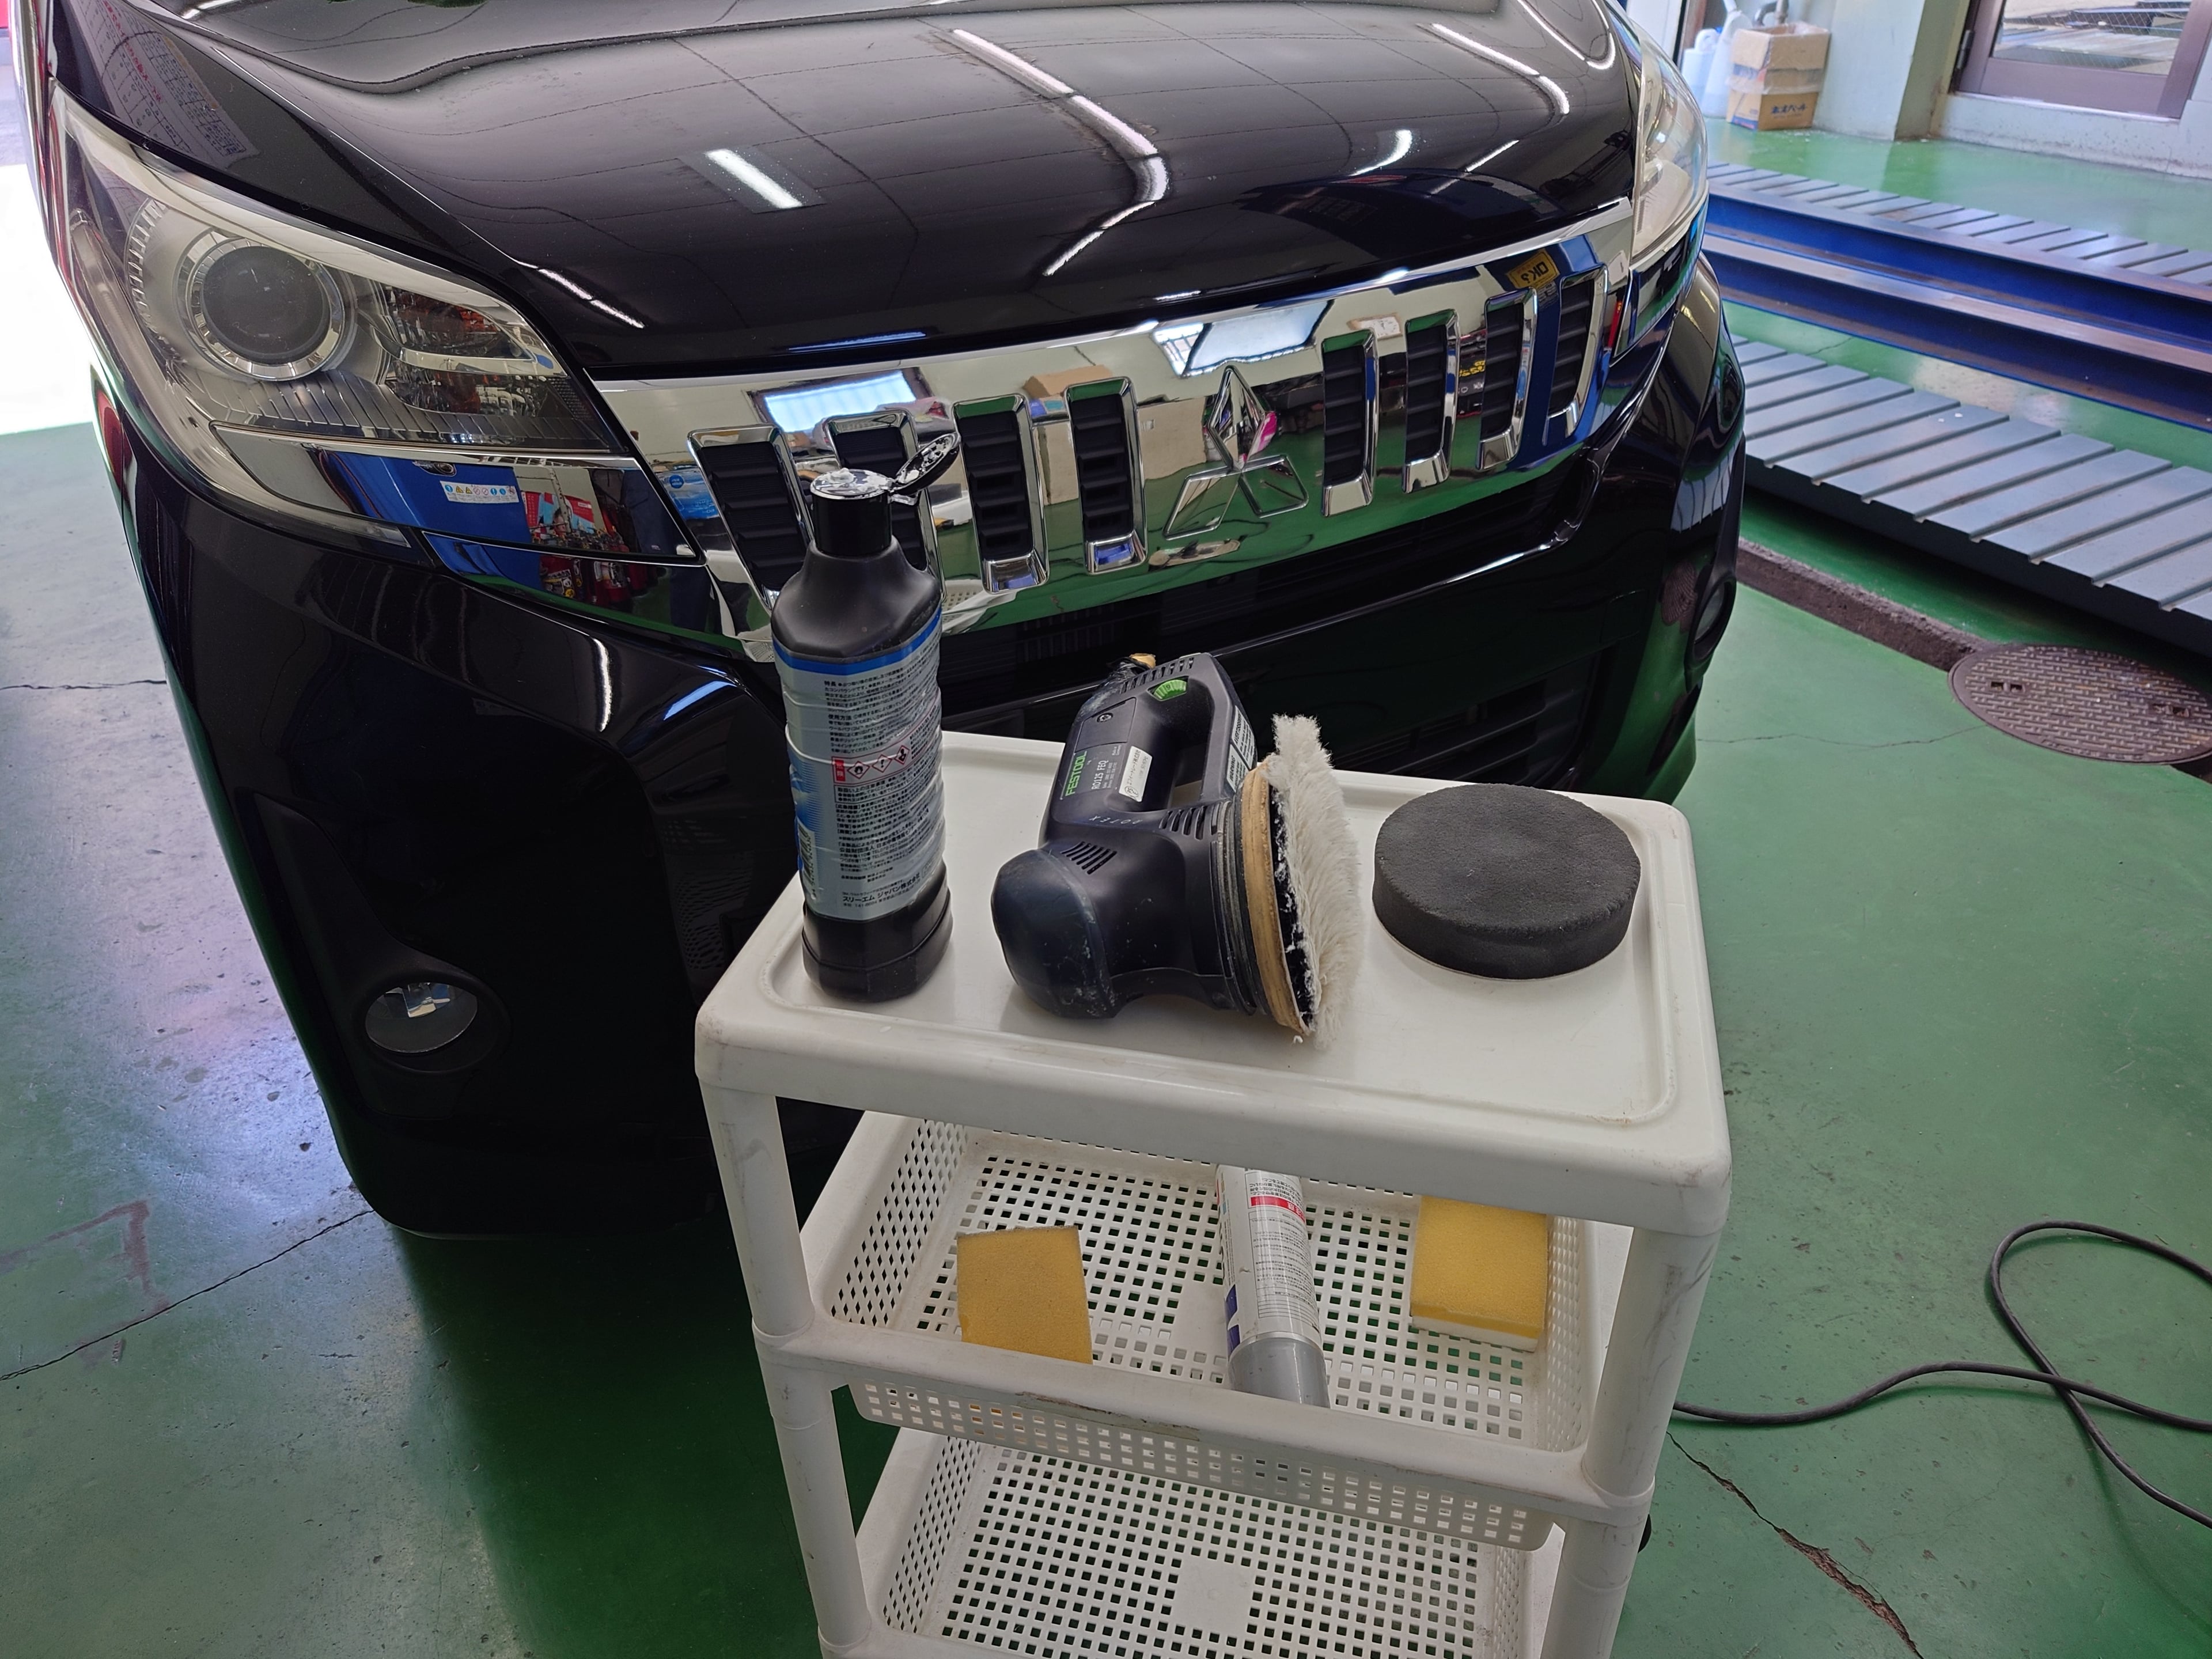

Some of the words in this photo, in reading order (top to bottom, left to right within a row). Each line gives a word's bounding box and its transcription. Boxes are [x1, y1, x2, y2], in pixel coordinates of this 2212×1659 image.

[1065, 751, 1087, 797] FESTOOL
[1097, 760, 1109, 771] FEQ
[1091, 772, 1104, 790] RO125
[843, 895, 875, 903] スリーエム
[877, 872, 921, 898] ジャパン株式会社
